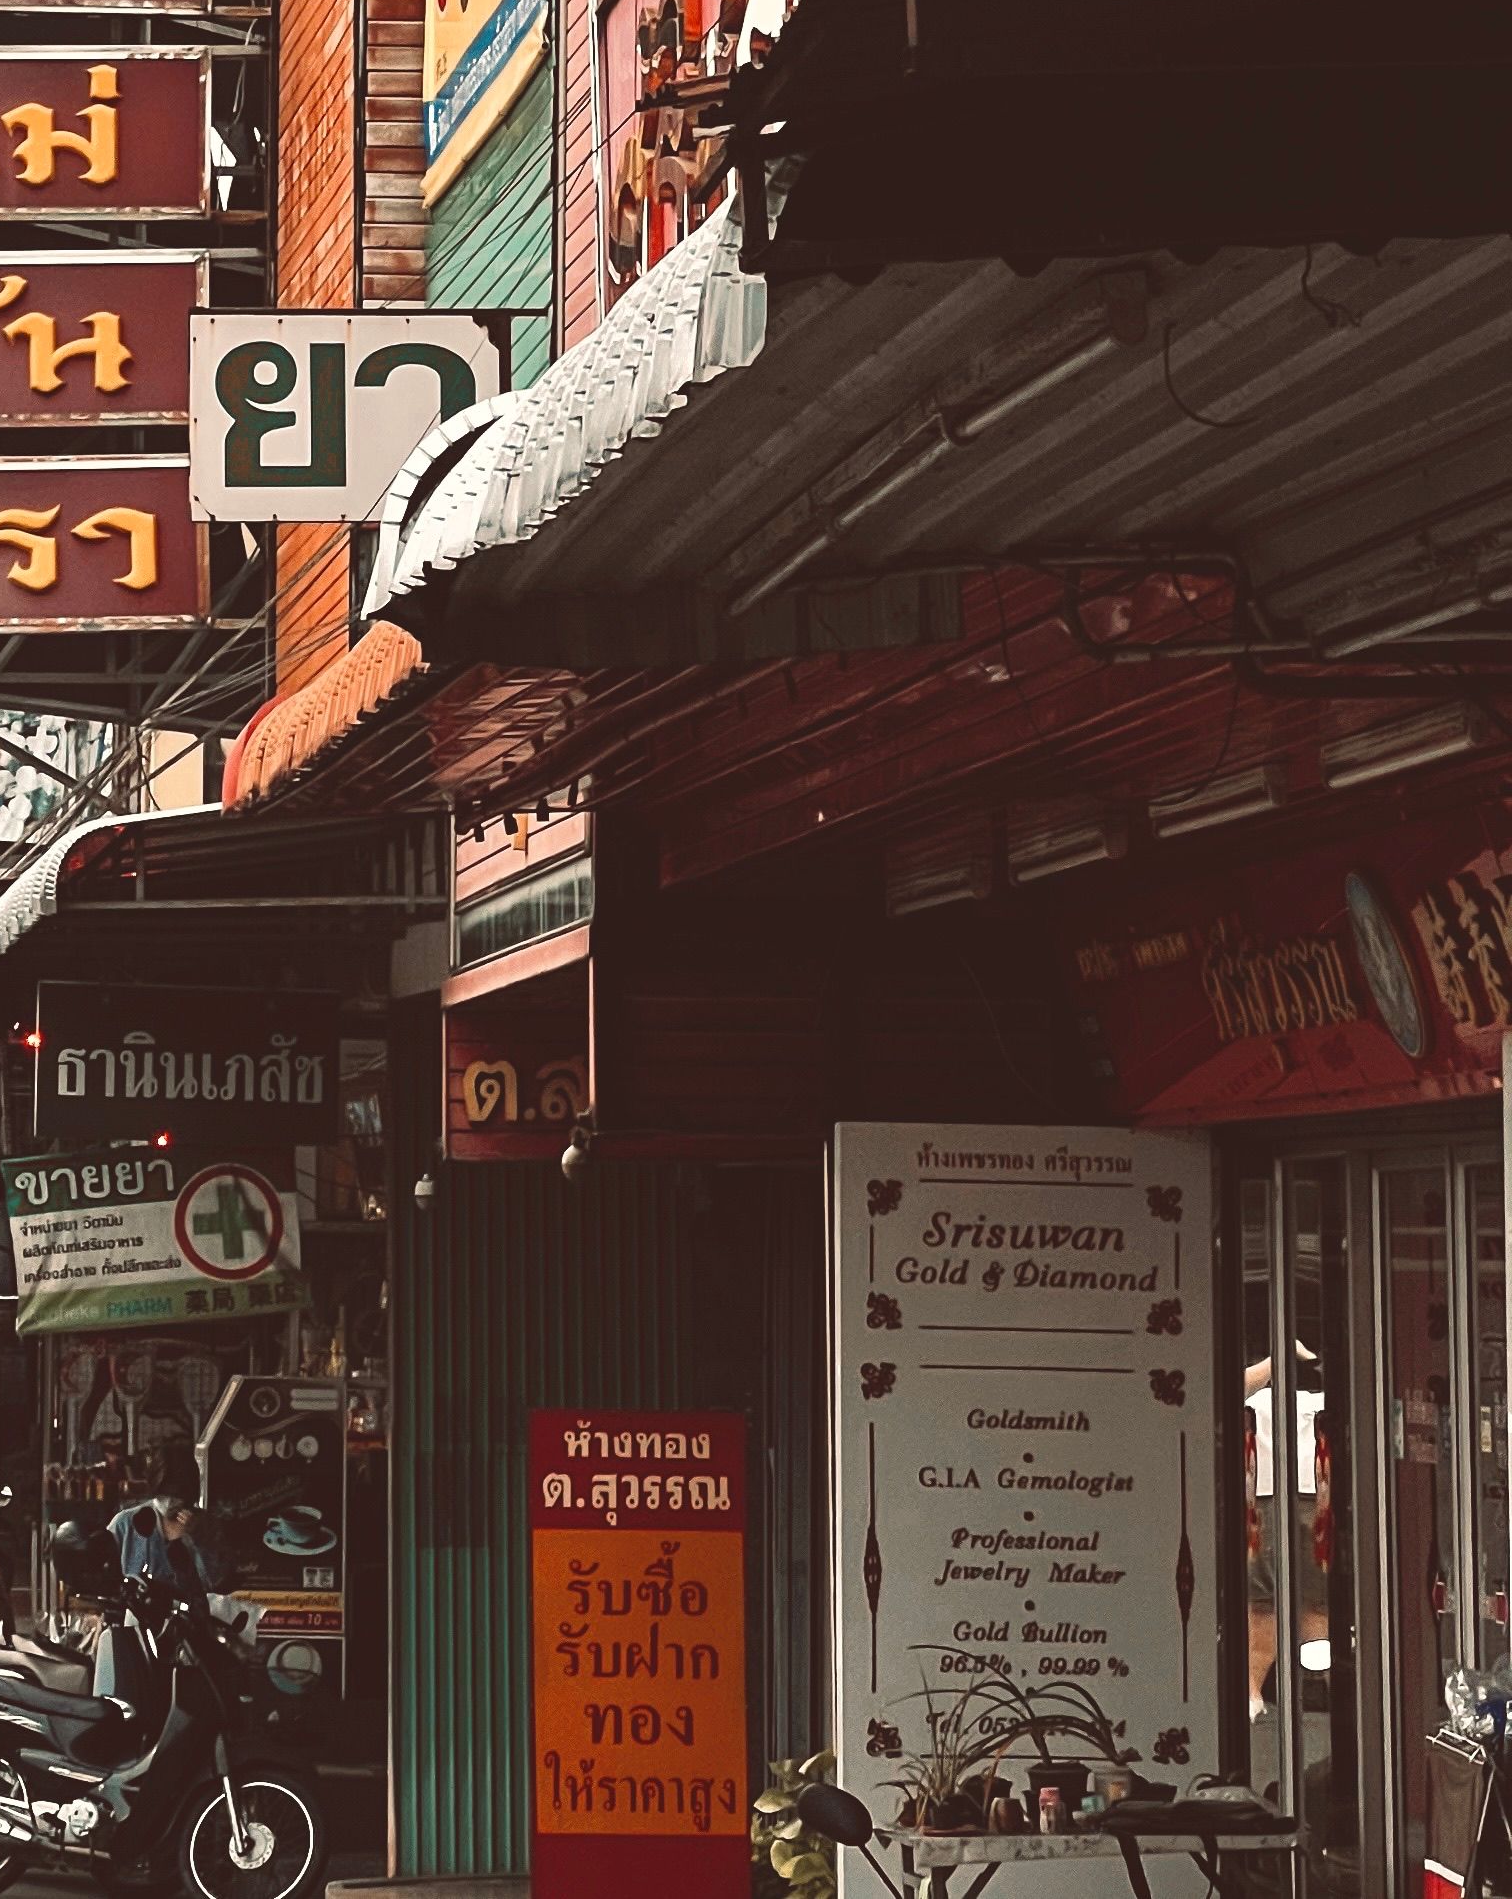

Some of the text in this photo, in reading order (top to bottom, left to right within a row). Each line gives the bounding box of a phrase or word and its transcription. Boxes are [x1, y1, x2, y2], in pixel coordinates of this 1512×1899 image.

[215, 341, 477, 488] ยา
[57, 1031, 325, 1103] ธานินเภสัช
[917, 1142, 1133, 1181] ห้างเพชรทอง ศรีสุวรรณ
[14, 1159, 176, 1206] ขายยา
[922, 1211, 1125, 1252] Srisuwan
[895, 1257, 1159, 1292] Gold & Diamond
[563, 1420, 711, 1461] ห้างทอง
[967, 1408, 1090, 1432] Goldsmith
[542, 1469, 731, 1526] ต.สุวรรณ
[918, 1467, 1134, 1498] G.I.A Gemologist
[951, 1527, 1100, 1551] Professional
[567, 1541, 709, 1617] รับซื้อ
[934, 1558, 1126, 1587] Jewelry Maker
[555, 1620, 720, 1680] รับฝาก
[952, 1620, 1108, 1644] Gold Bullion
[584, 1702, 695, 1746] ทอง
[545, 1751, 736, 1831] ให้ราคาสูง
